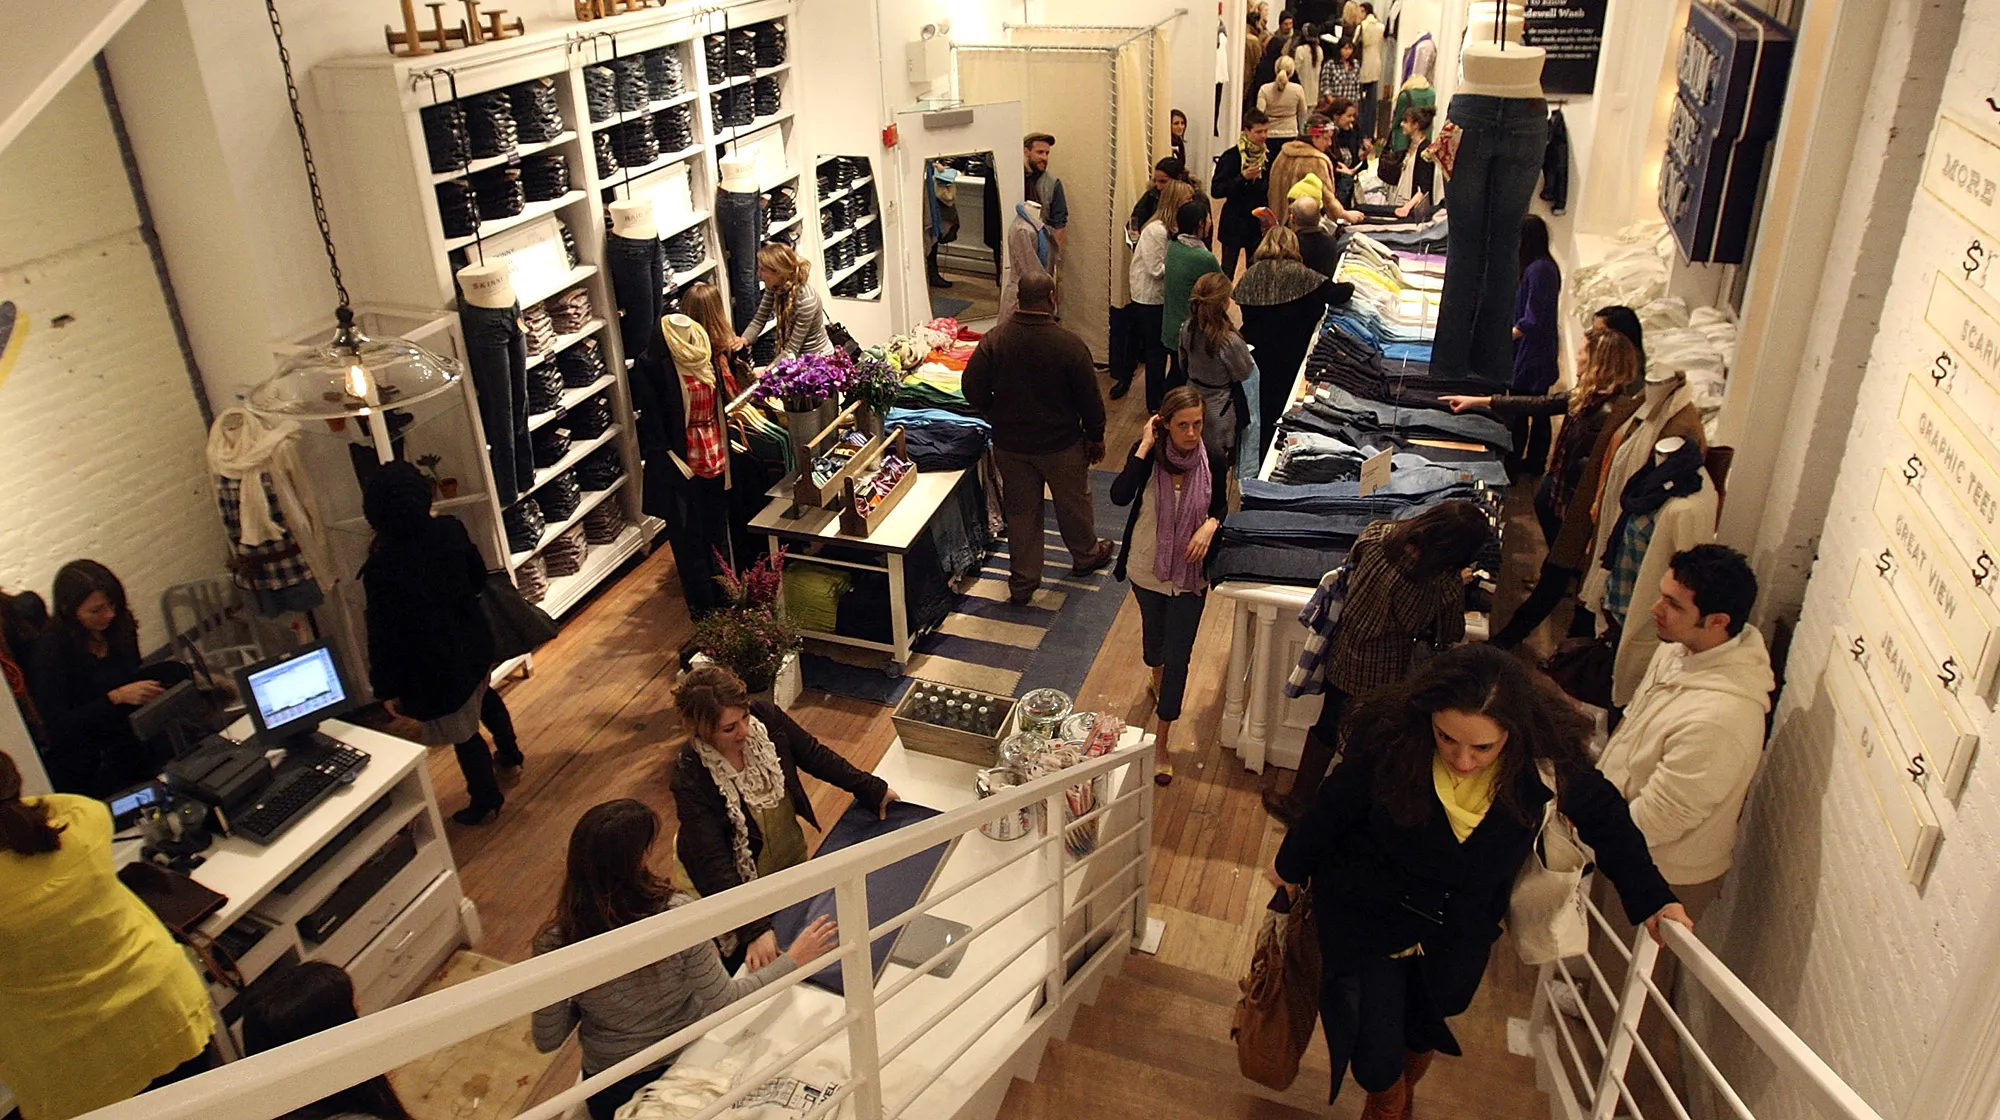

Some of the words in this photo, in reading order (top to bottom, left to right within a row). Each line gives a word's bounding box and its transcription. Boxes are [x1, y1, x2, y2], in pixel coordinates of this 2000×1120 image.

[1523, 7, 1557, 18] dewell
[1942, 153, 1996, 207] MORE
[1961, 318, 2000, 378] SCARV
[1919, 412, 1965, 484] GRAPHIC
[1967, 471, 1998, 525] TEES
[1896, 514, 1927, 571] GREAT
[1928, 563, 1957, 620] VIEW
[1881, 631, 1912, 693] JEANS
